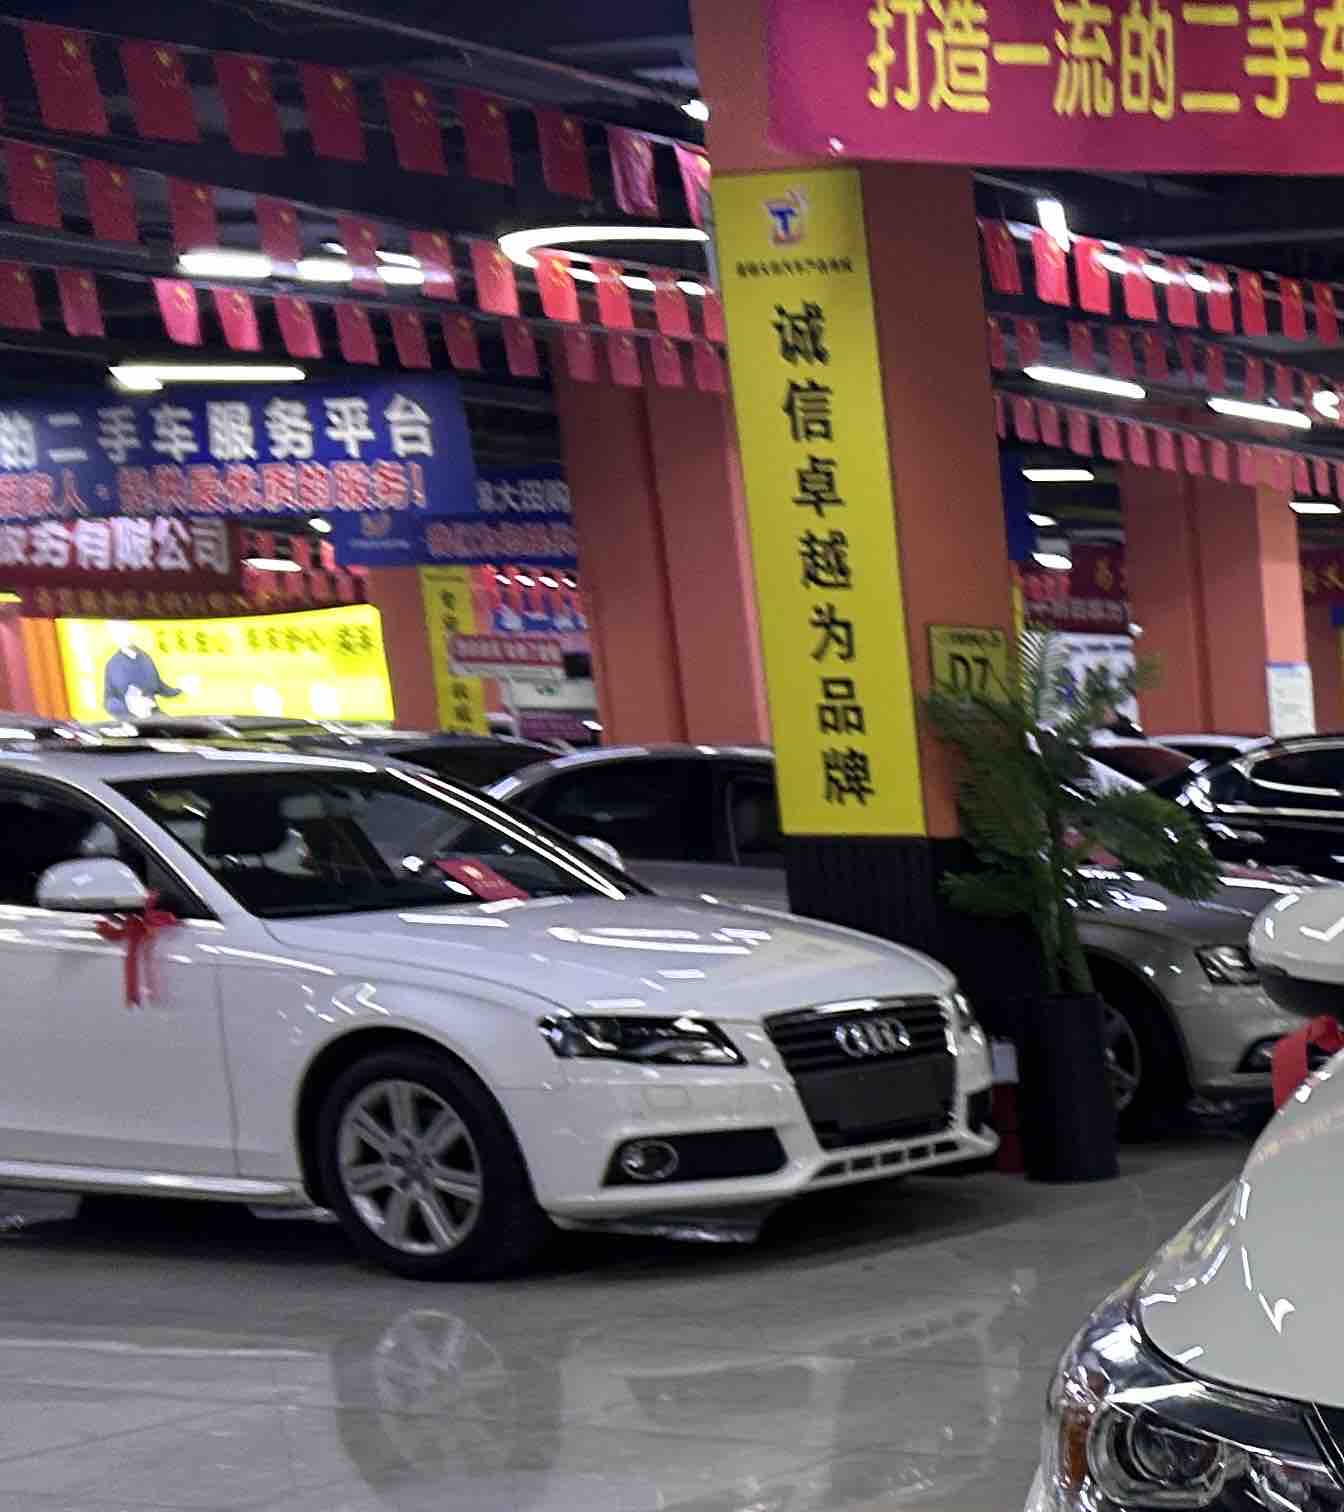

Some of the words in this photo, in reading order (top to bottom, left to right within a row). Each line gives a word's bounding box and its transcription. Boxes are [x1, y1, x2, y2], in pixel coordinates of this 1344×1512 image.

[772, 301, 876, 808] 诚信卓越为品牌
